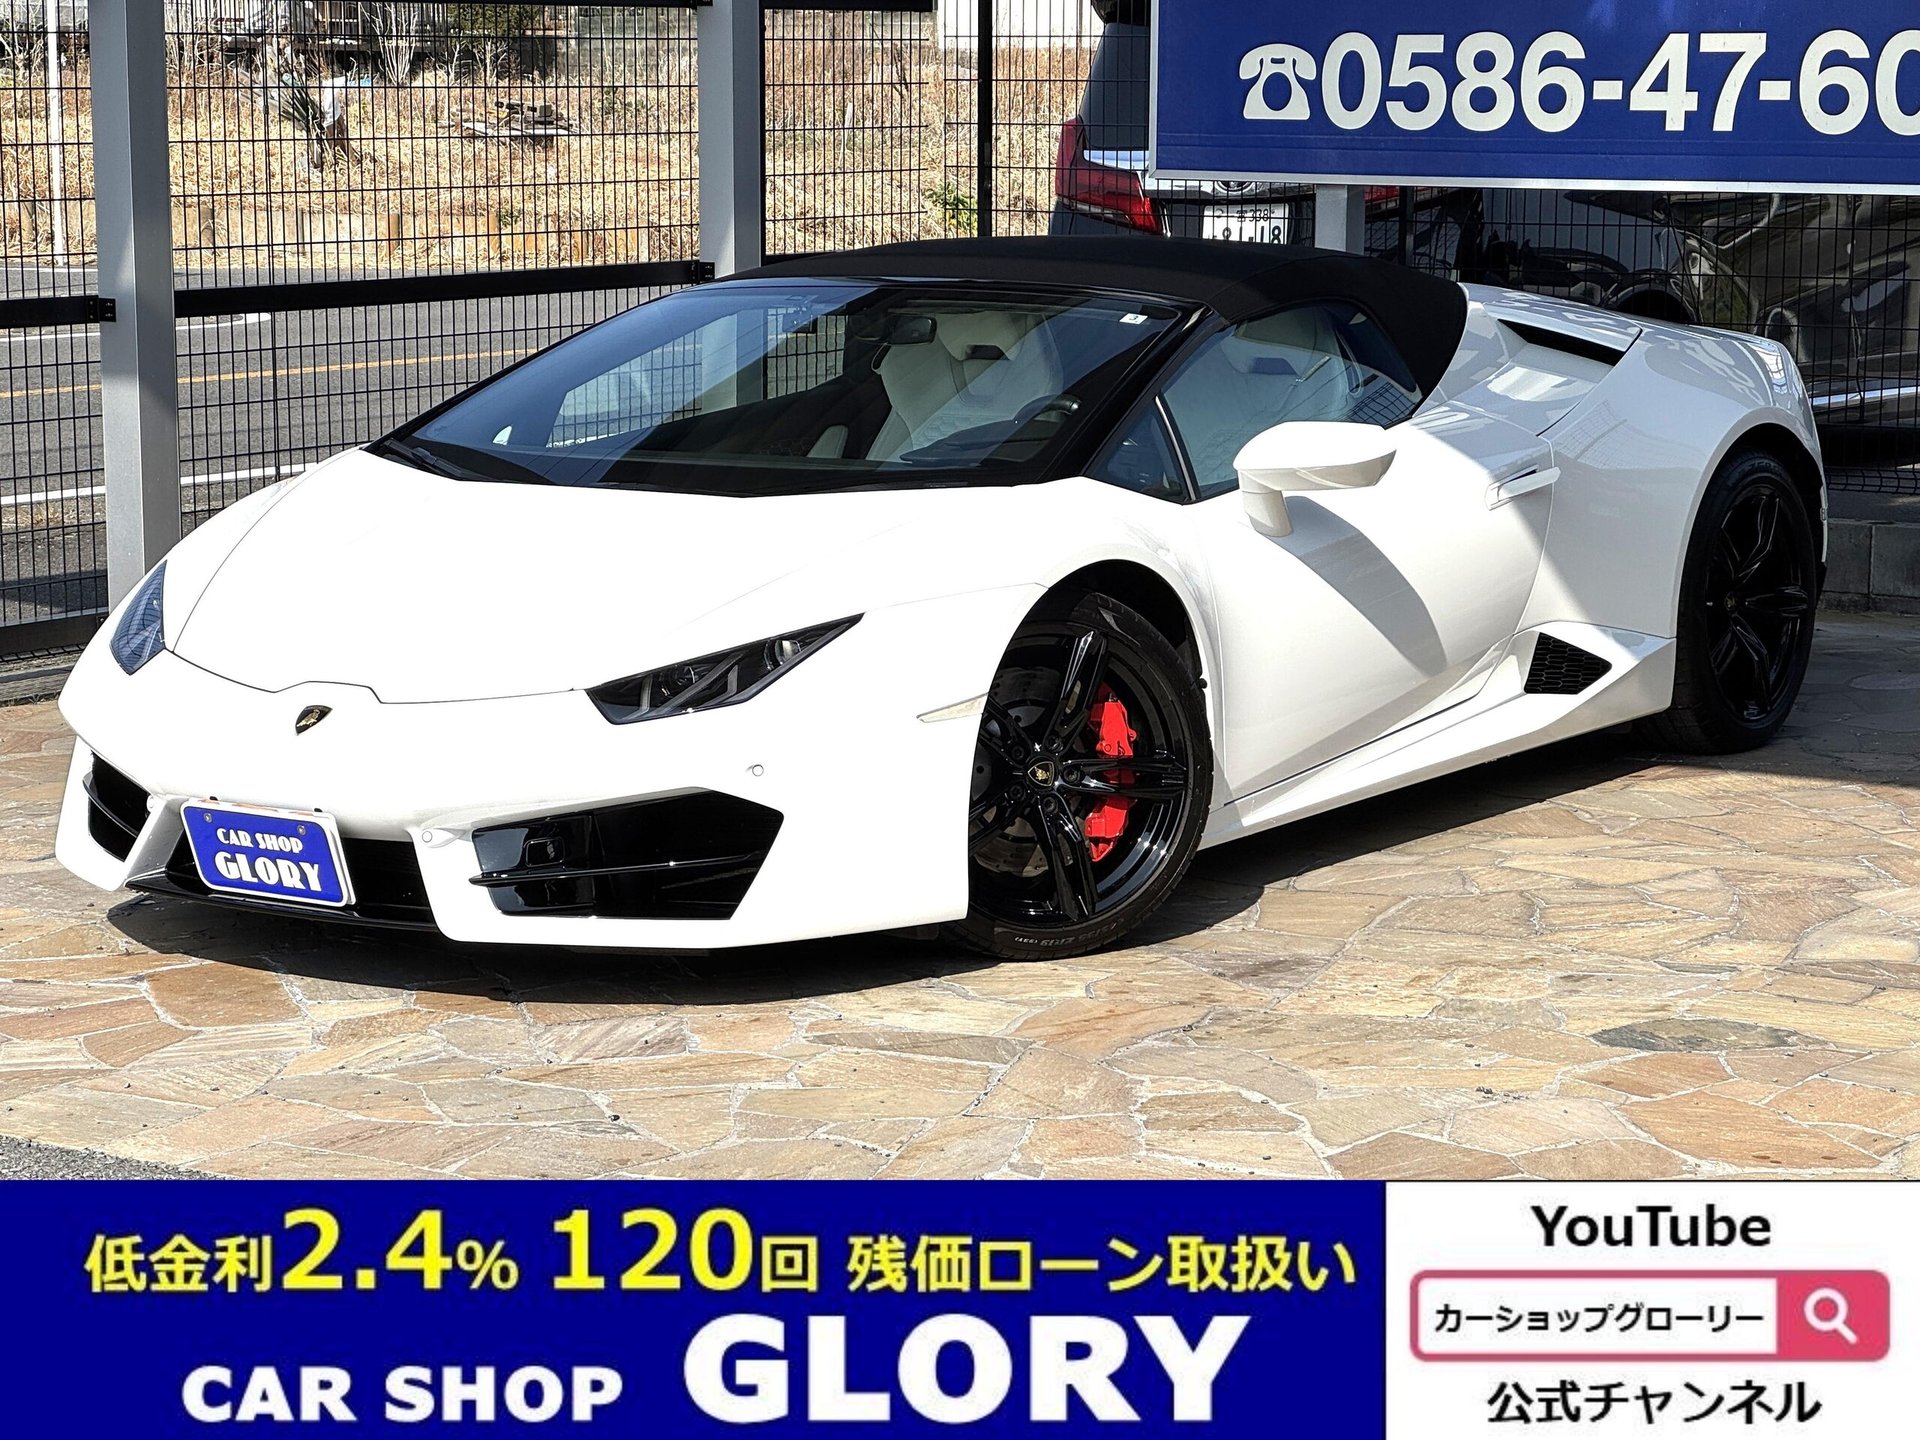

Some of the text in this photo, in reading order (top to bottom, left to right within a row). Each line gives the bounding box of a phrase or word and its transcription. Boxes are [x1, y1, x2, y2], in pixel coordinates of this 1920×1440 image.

[216, 828, 303, 854] CAR SHOP
[214, 851, 322, 892] GLORY
